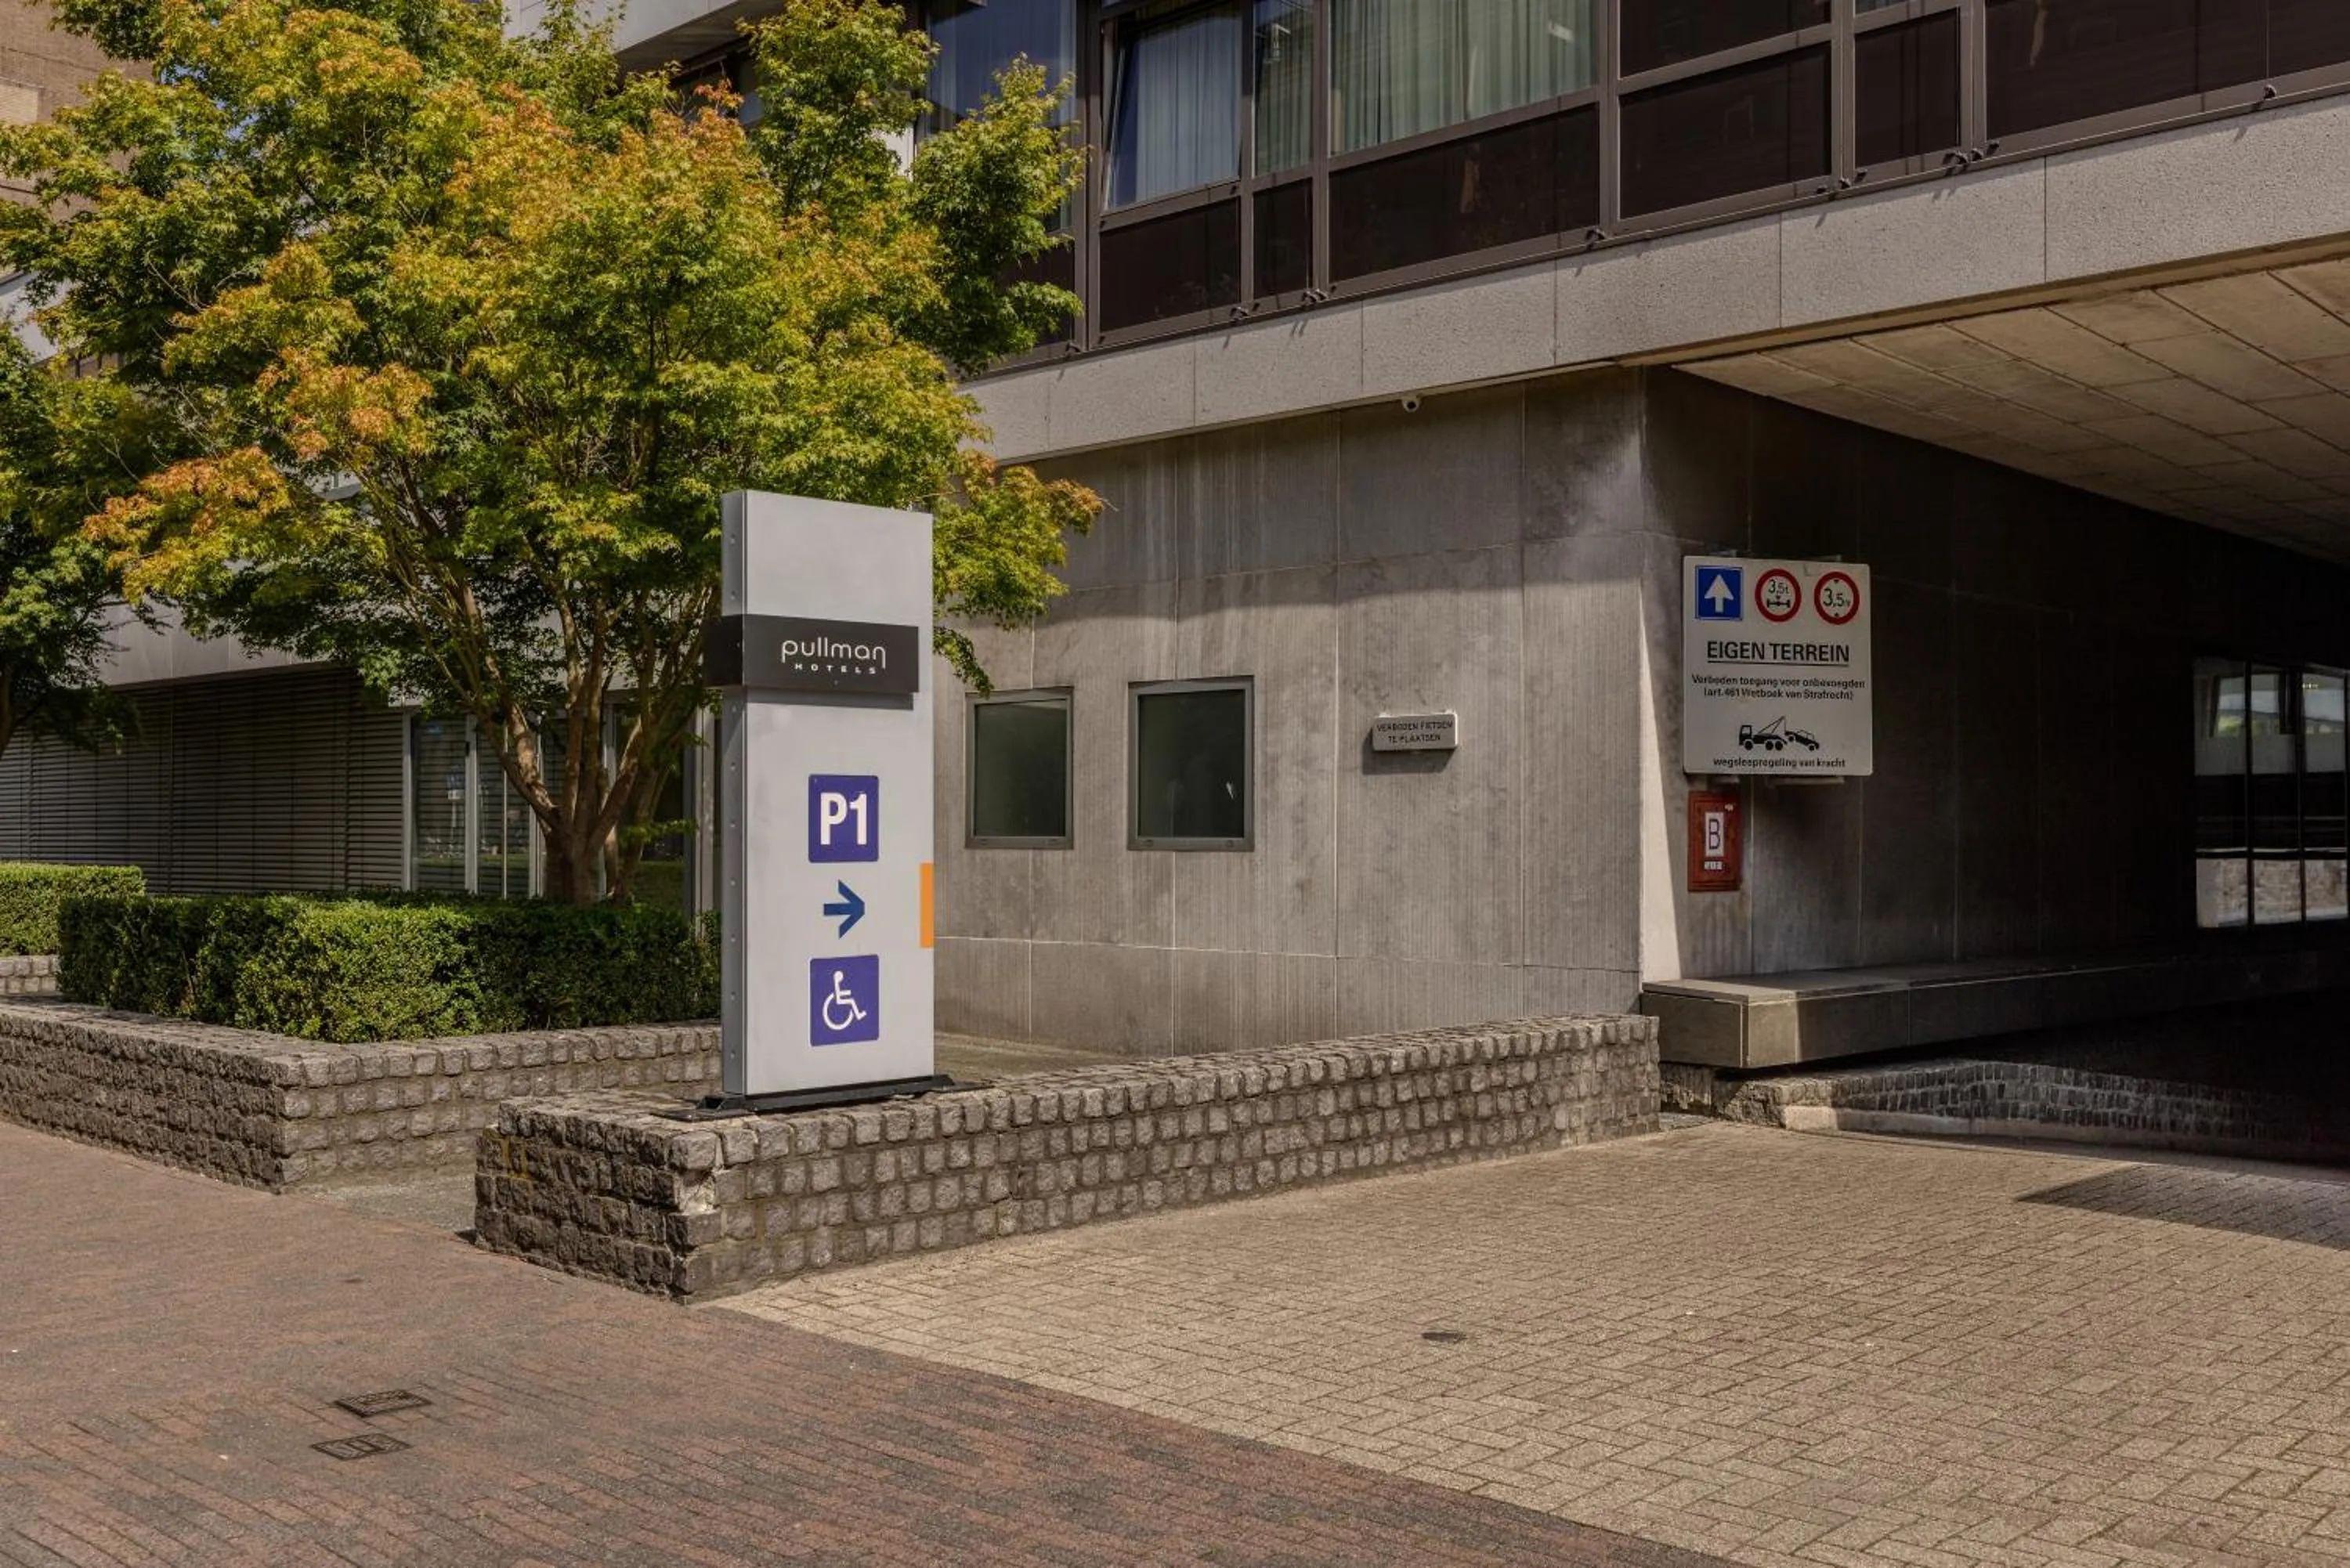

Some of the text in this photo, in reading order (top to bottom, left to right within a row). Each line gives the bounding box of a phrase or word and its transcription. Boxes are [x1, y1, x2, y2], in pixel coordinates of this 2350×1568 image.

[781, 637, 886, 670] pullman
[1707, 641, 1849, 663] EIGEN TERREIN
[794, 663, 877, 674] HOTELS
[1691, 674, 1865, 690] Verboden toegang voor onbevoegden
[1724, 688, 1741, 697] 461
[1741, 688, 1783, 698] Wetboek
[1376, 721, 1453, 732] VERBODEN FIETSEN
[1400, 733, 1441, 742] PLAATSEN
[1713, 757, 1797, 768] wegsleepregeling
[1817, 758, 1846, 768] kracht
[819, 792, 867, 845] P1
